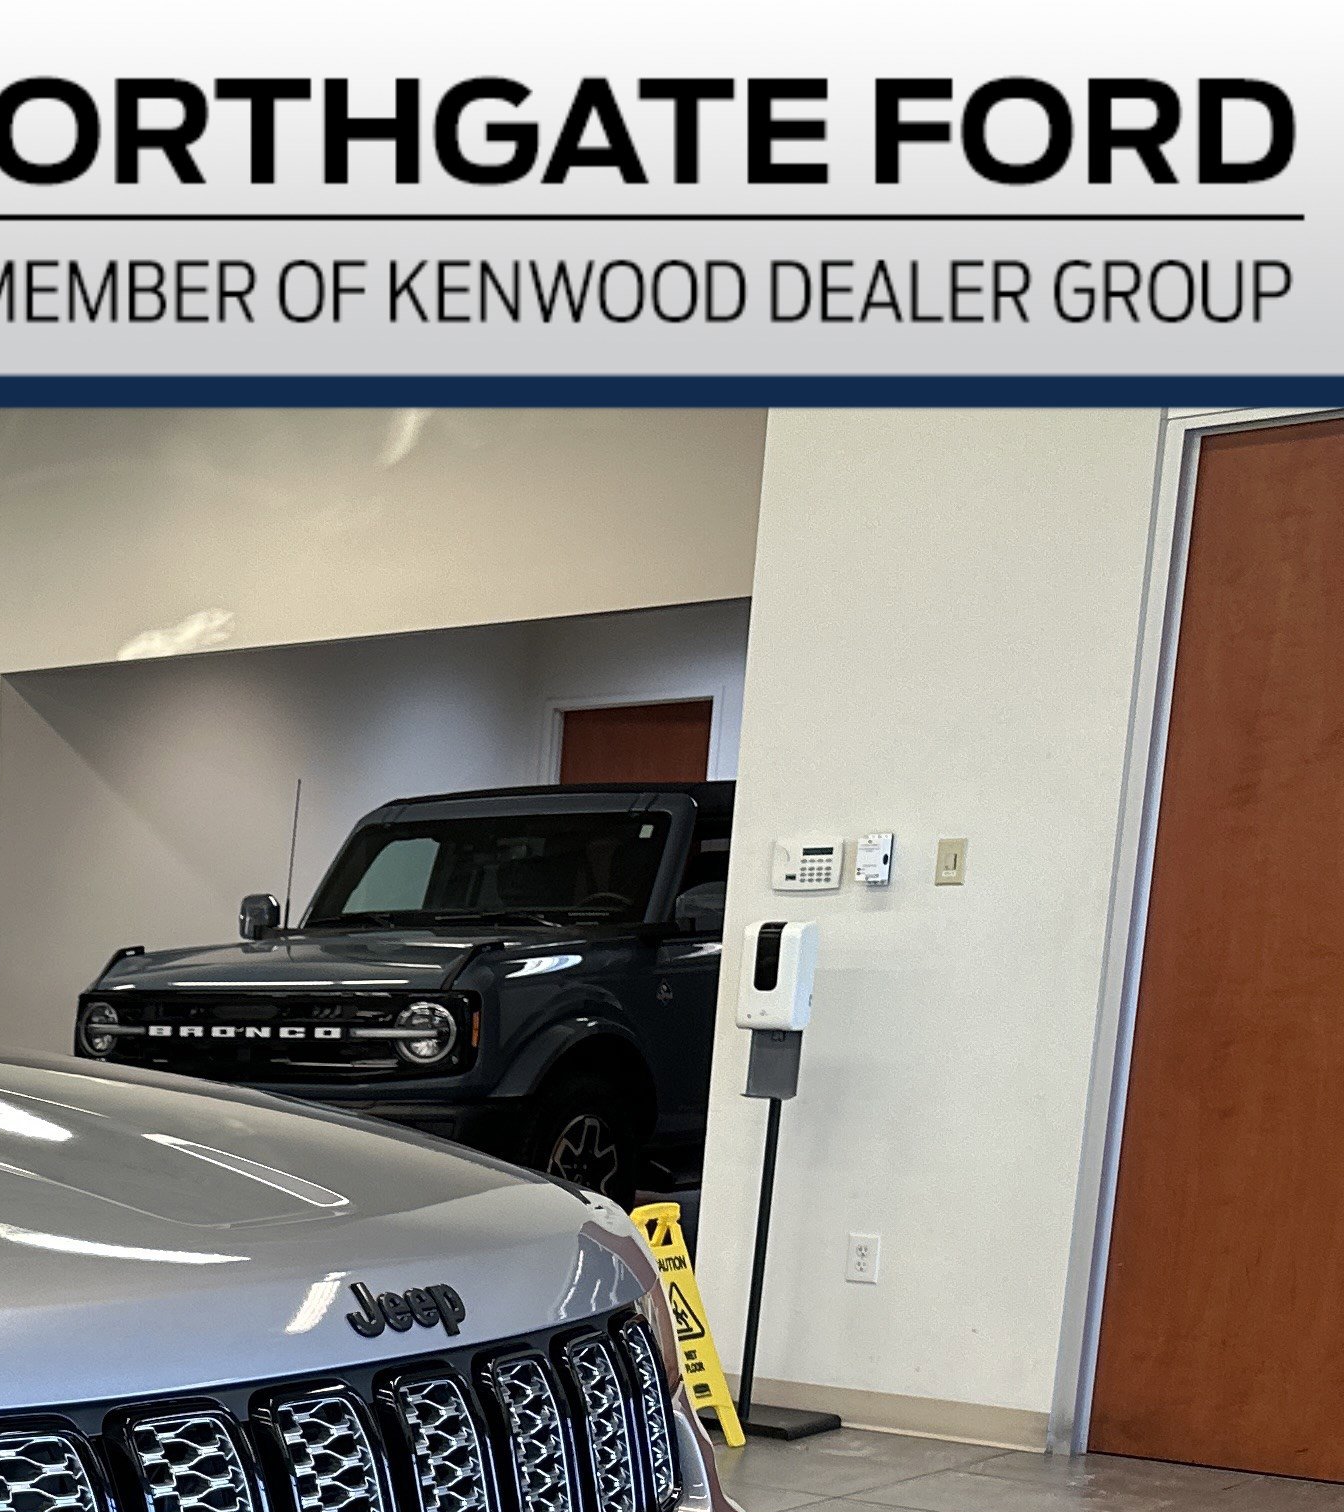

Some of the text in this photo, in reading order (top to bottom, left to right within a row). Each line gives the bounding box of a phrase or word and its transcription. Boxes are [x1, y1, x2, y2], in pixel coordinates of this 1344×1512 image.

[148, 1025, 343, 1039] BRONCO
[658, 1255, 687, 1273] AUTION
[346, 1281, 466, 1338] Jeep
